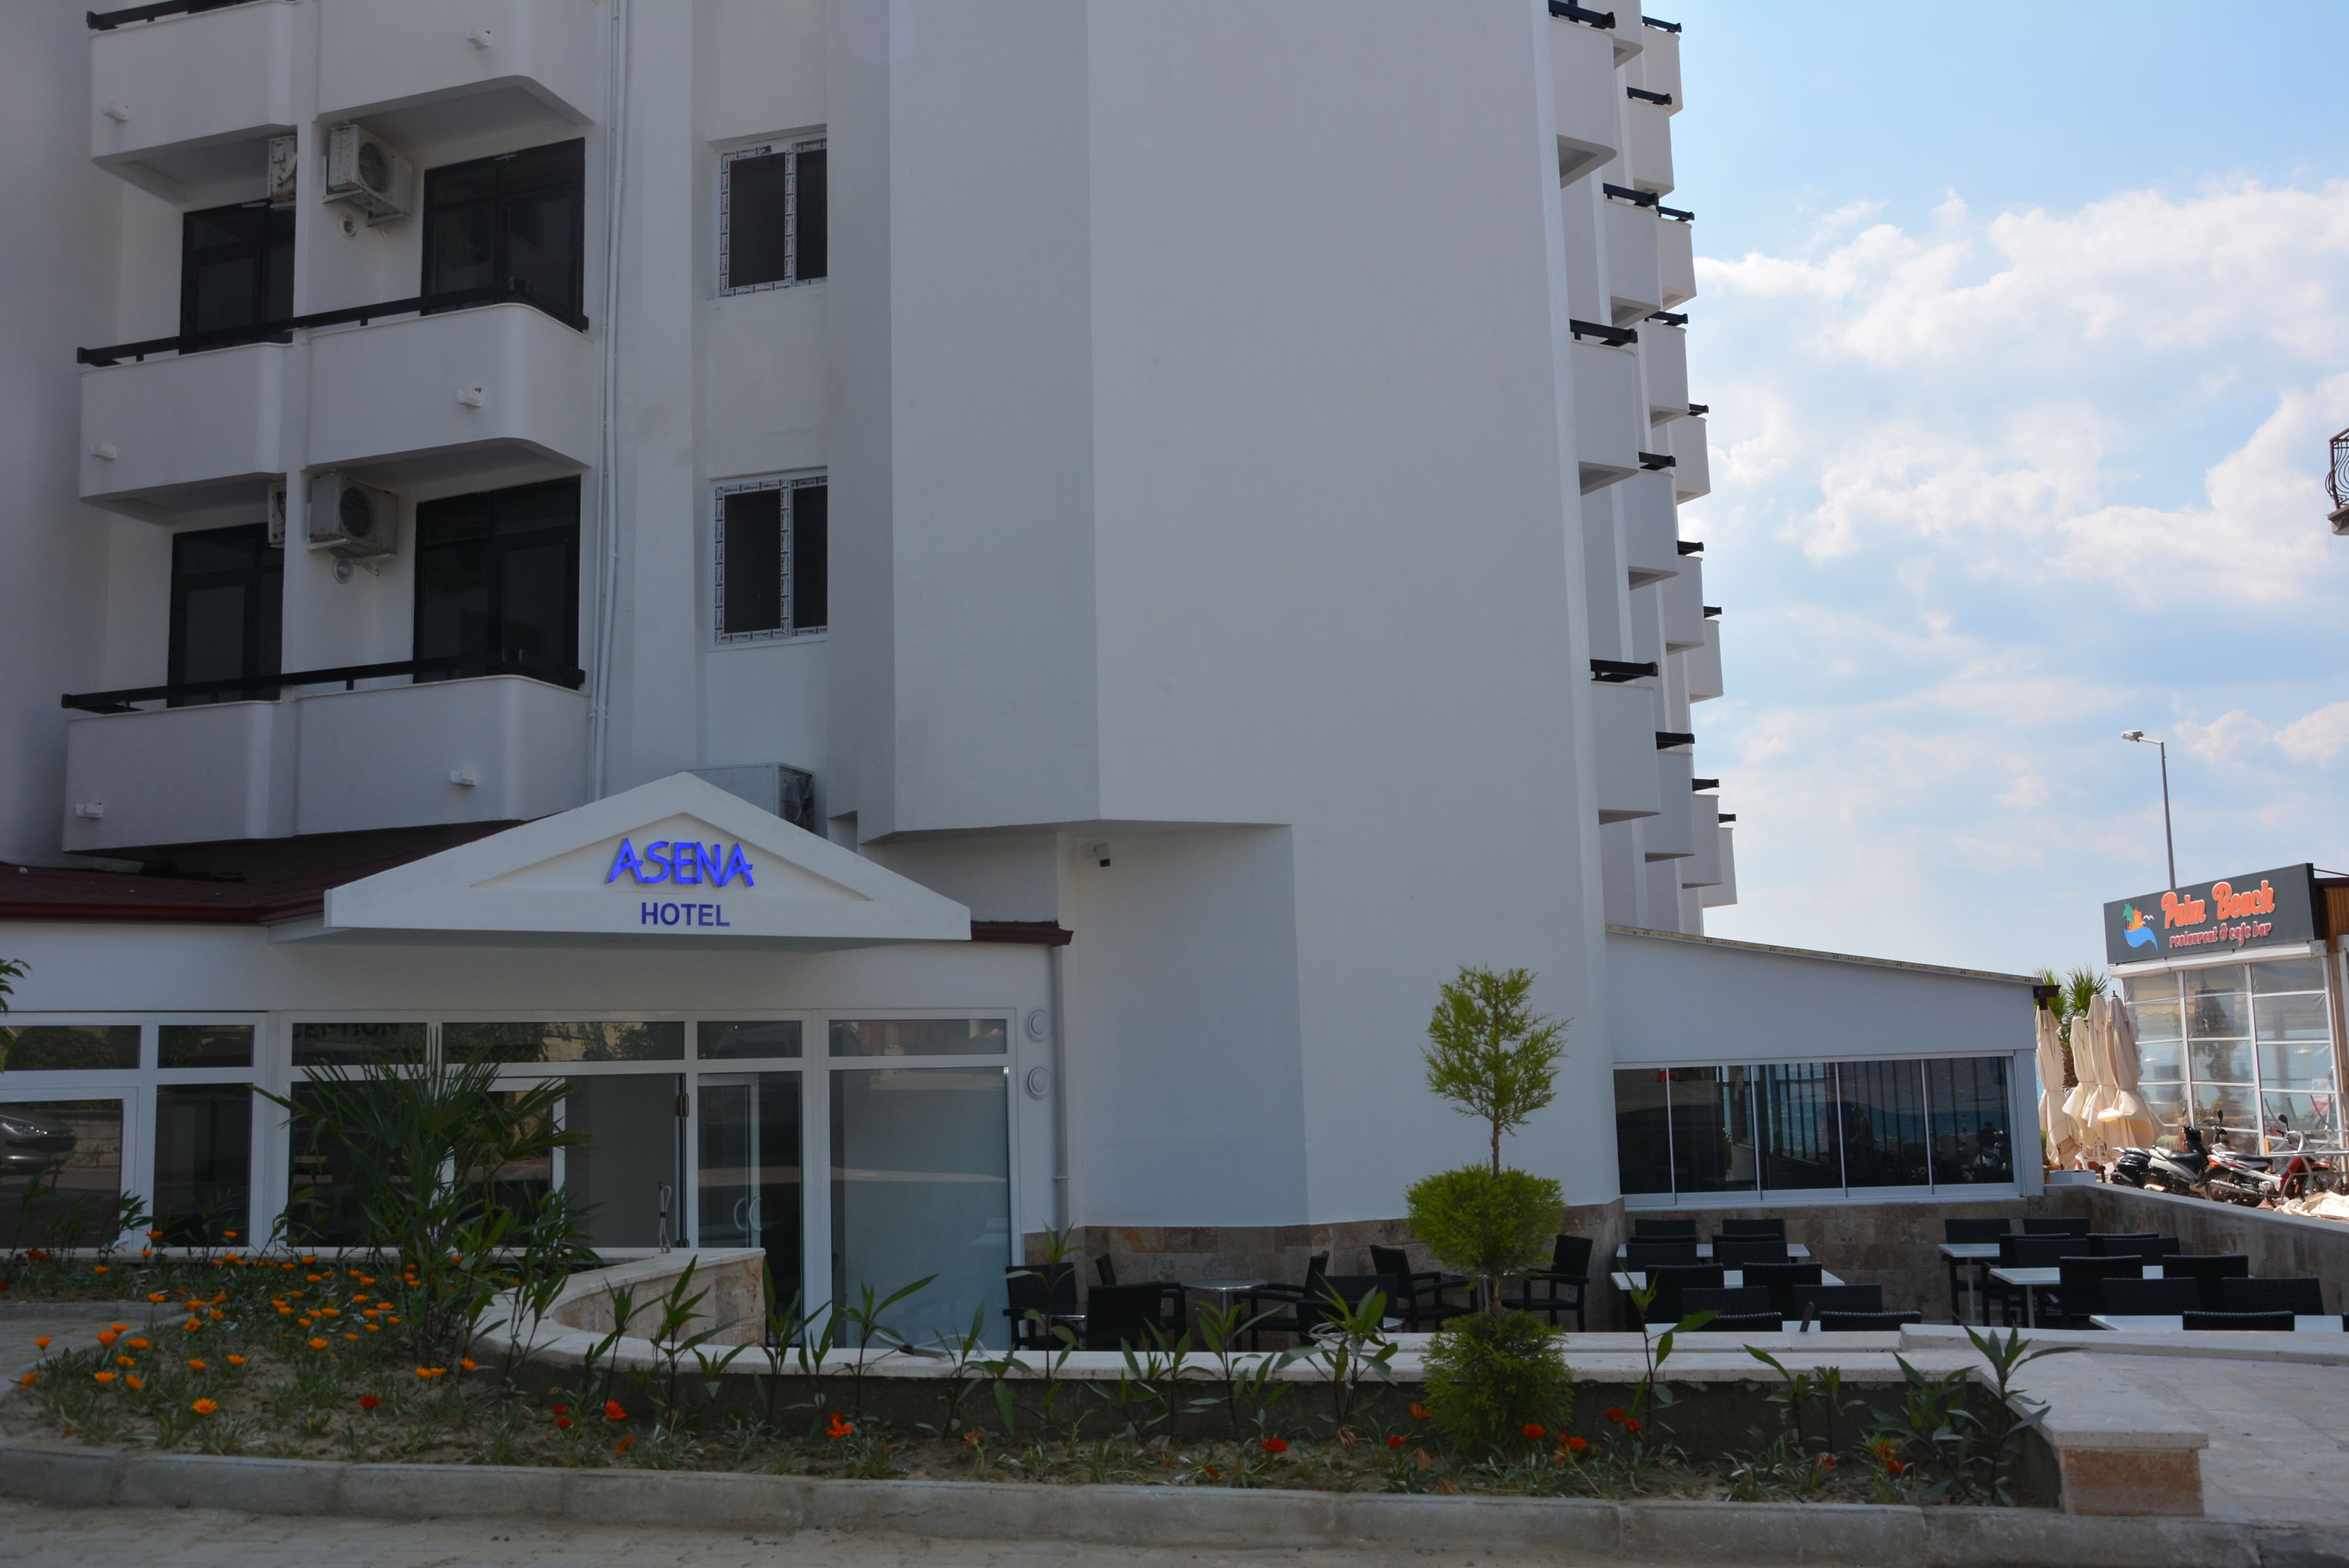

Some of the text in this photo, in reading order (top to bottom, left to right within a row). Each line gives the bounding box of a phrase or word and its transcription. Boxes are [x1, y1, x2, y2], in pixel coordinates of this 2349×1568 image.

[606, 838, 754, 888] ASENA
[641, 902, 730, 926] HOTEL
[2161, 880, 2275, 928] Palm Beach
[2170, 920, 2271, 947] restaurant & cafe bar
